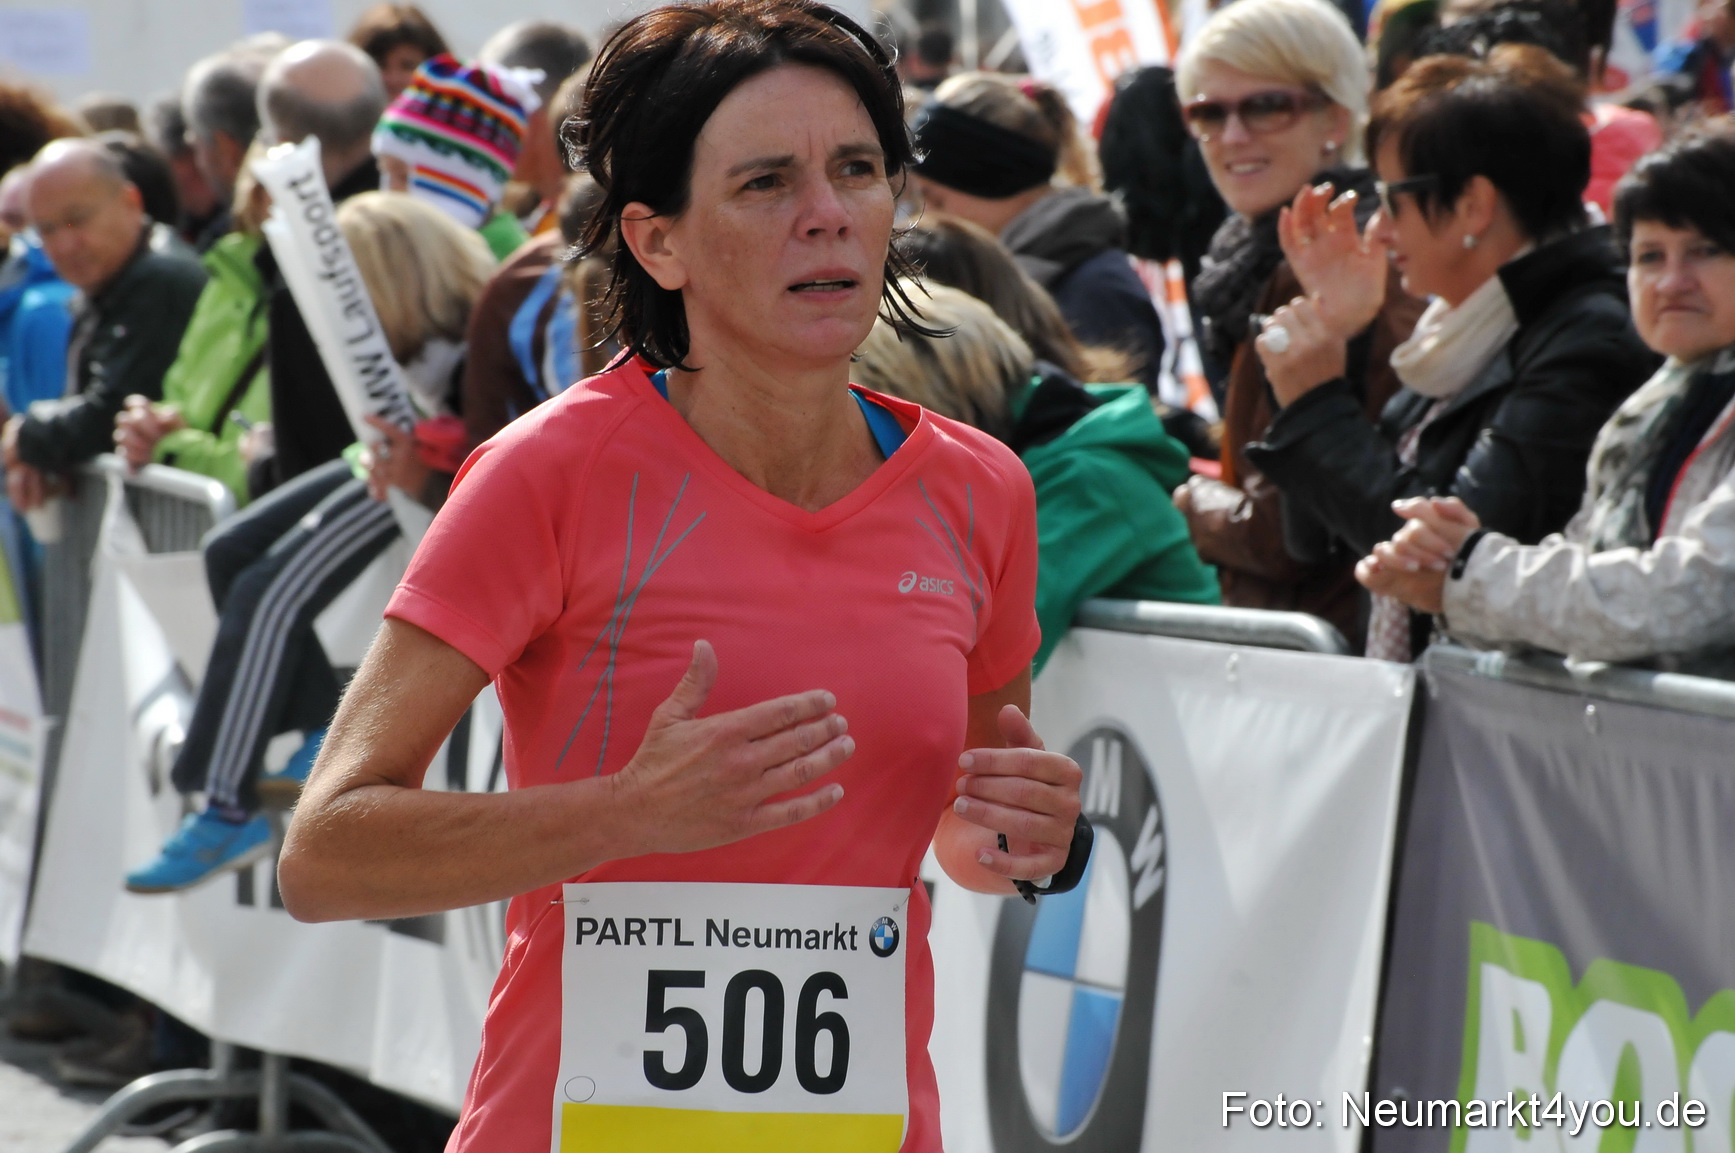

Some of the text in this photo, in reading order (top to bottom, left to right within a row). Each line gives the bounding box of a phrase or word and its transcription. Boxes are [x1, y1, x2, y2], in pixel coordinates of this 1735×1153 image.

[287, 171, 375, 347] Laufsport
[919, 575, 954, 595] asics
[575, 917, 858, 951] PARTL Neumarkt
[642, 968, 851, 1095] 506
